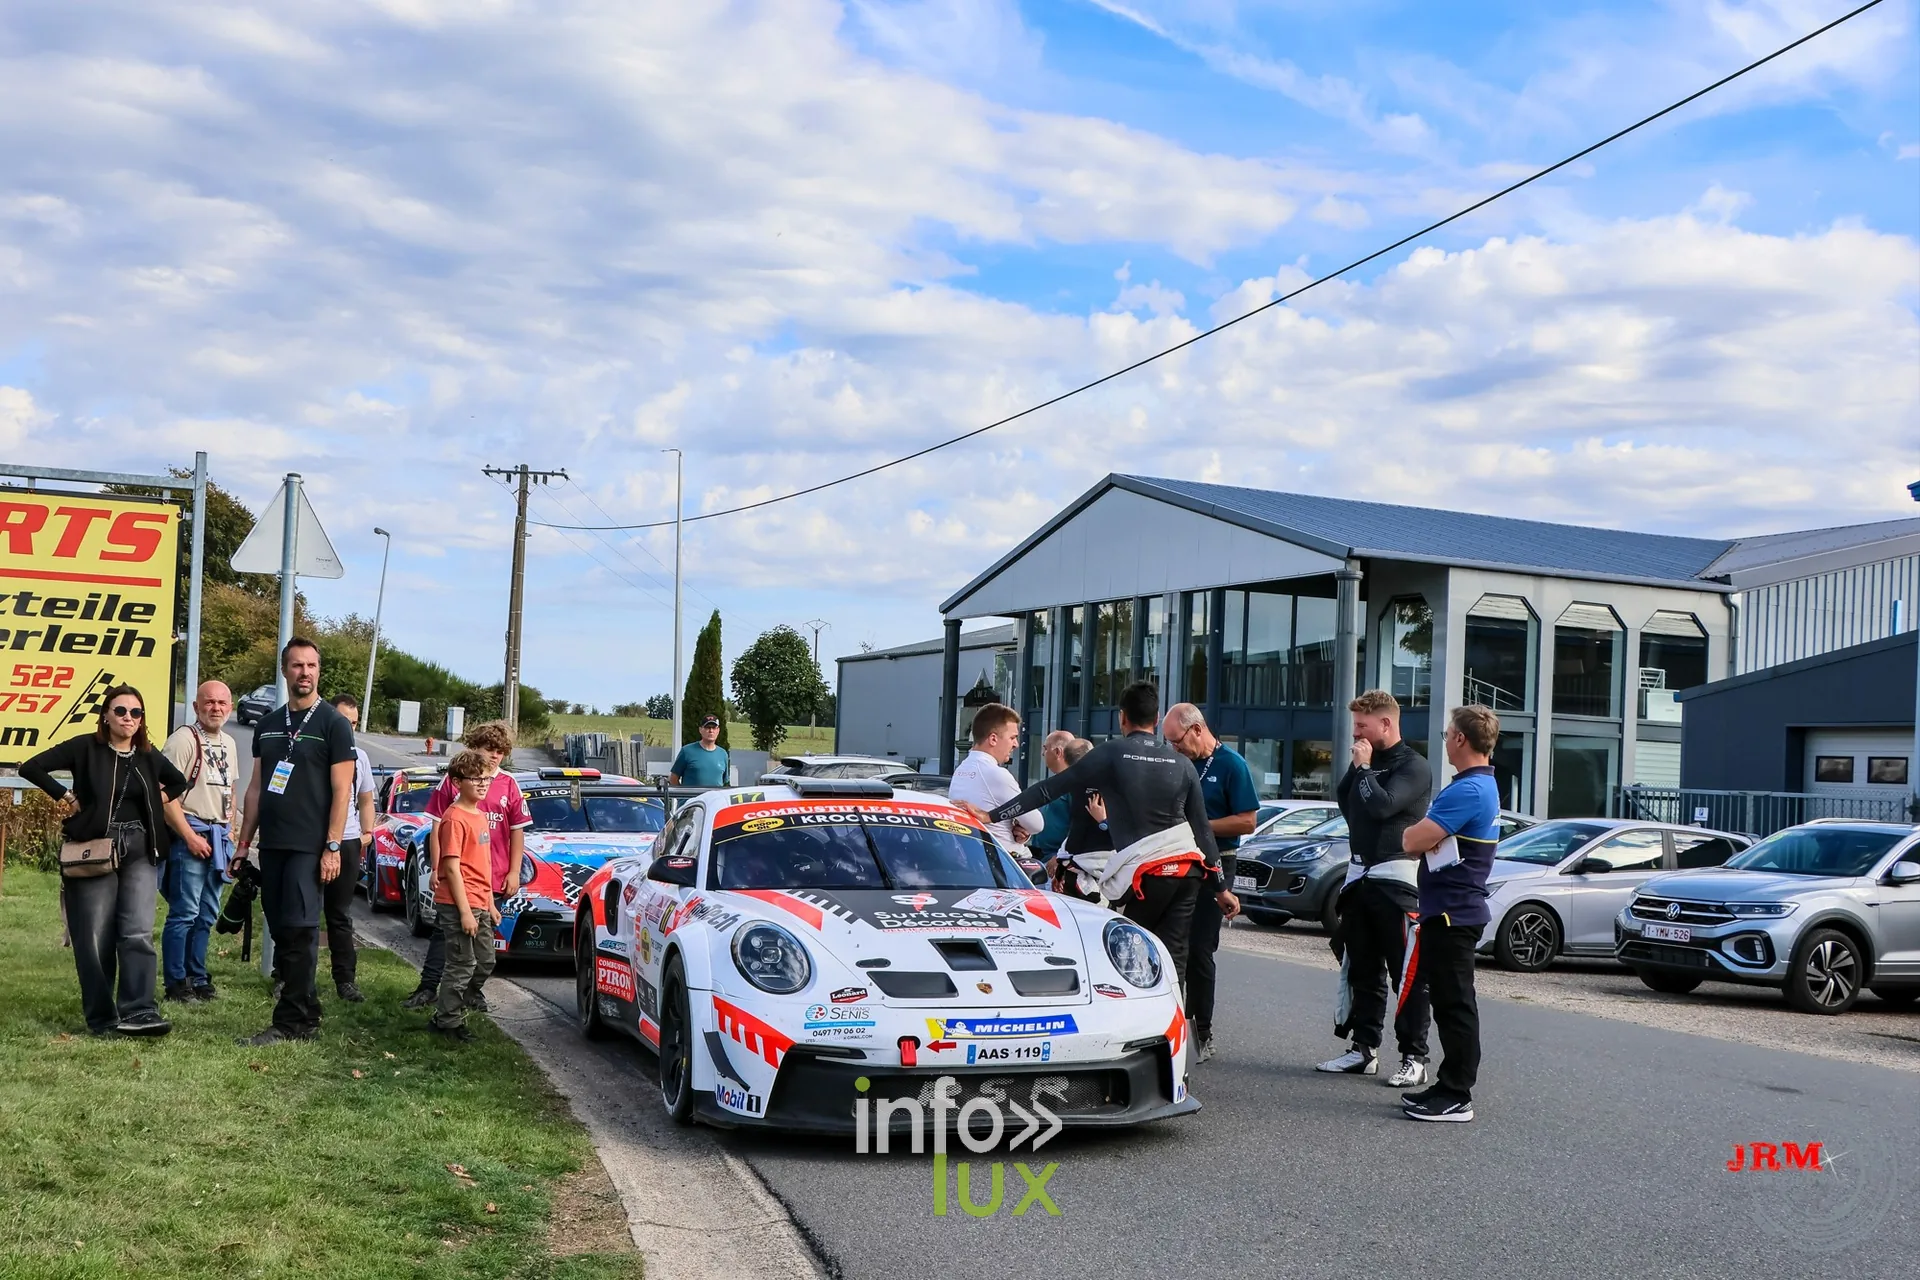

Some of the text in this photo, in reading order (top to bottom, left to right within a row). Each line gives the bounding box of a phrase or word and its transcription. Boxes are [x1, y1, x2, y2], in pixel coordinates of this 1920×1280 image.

[0, 502, 169, 562] RTS
[10, 664, 75, 688] 522
[1122, 754, 1176, 764] PORSCHE
[1360, 779, 1371, 798] OMP
[732, 792, 762, 804] 17
[895, 808, 956, 821] PIRON
[1000, 804, 1022, 820] OMP
[747, 821, 779, 829] KROON
[801, 814, 919, 826] KROON-OIL
[1162, 863, 1179, 871] OMP
[874, 910, 992, 920] Surfaces
[598, 968, 631, 990] PIRON
[830, 1006, 870, 1020] SENIS
[813, 1029, 832, 1037] 0497
[833, 1028, 842, 1036] 79
[975, 1021, 1065, 1033] MICHELIN
[978, 1047, 1041, 1059] AAS 119
[716, 1083, 745, 1109] Mobil
